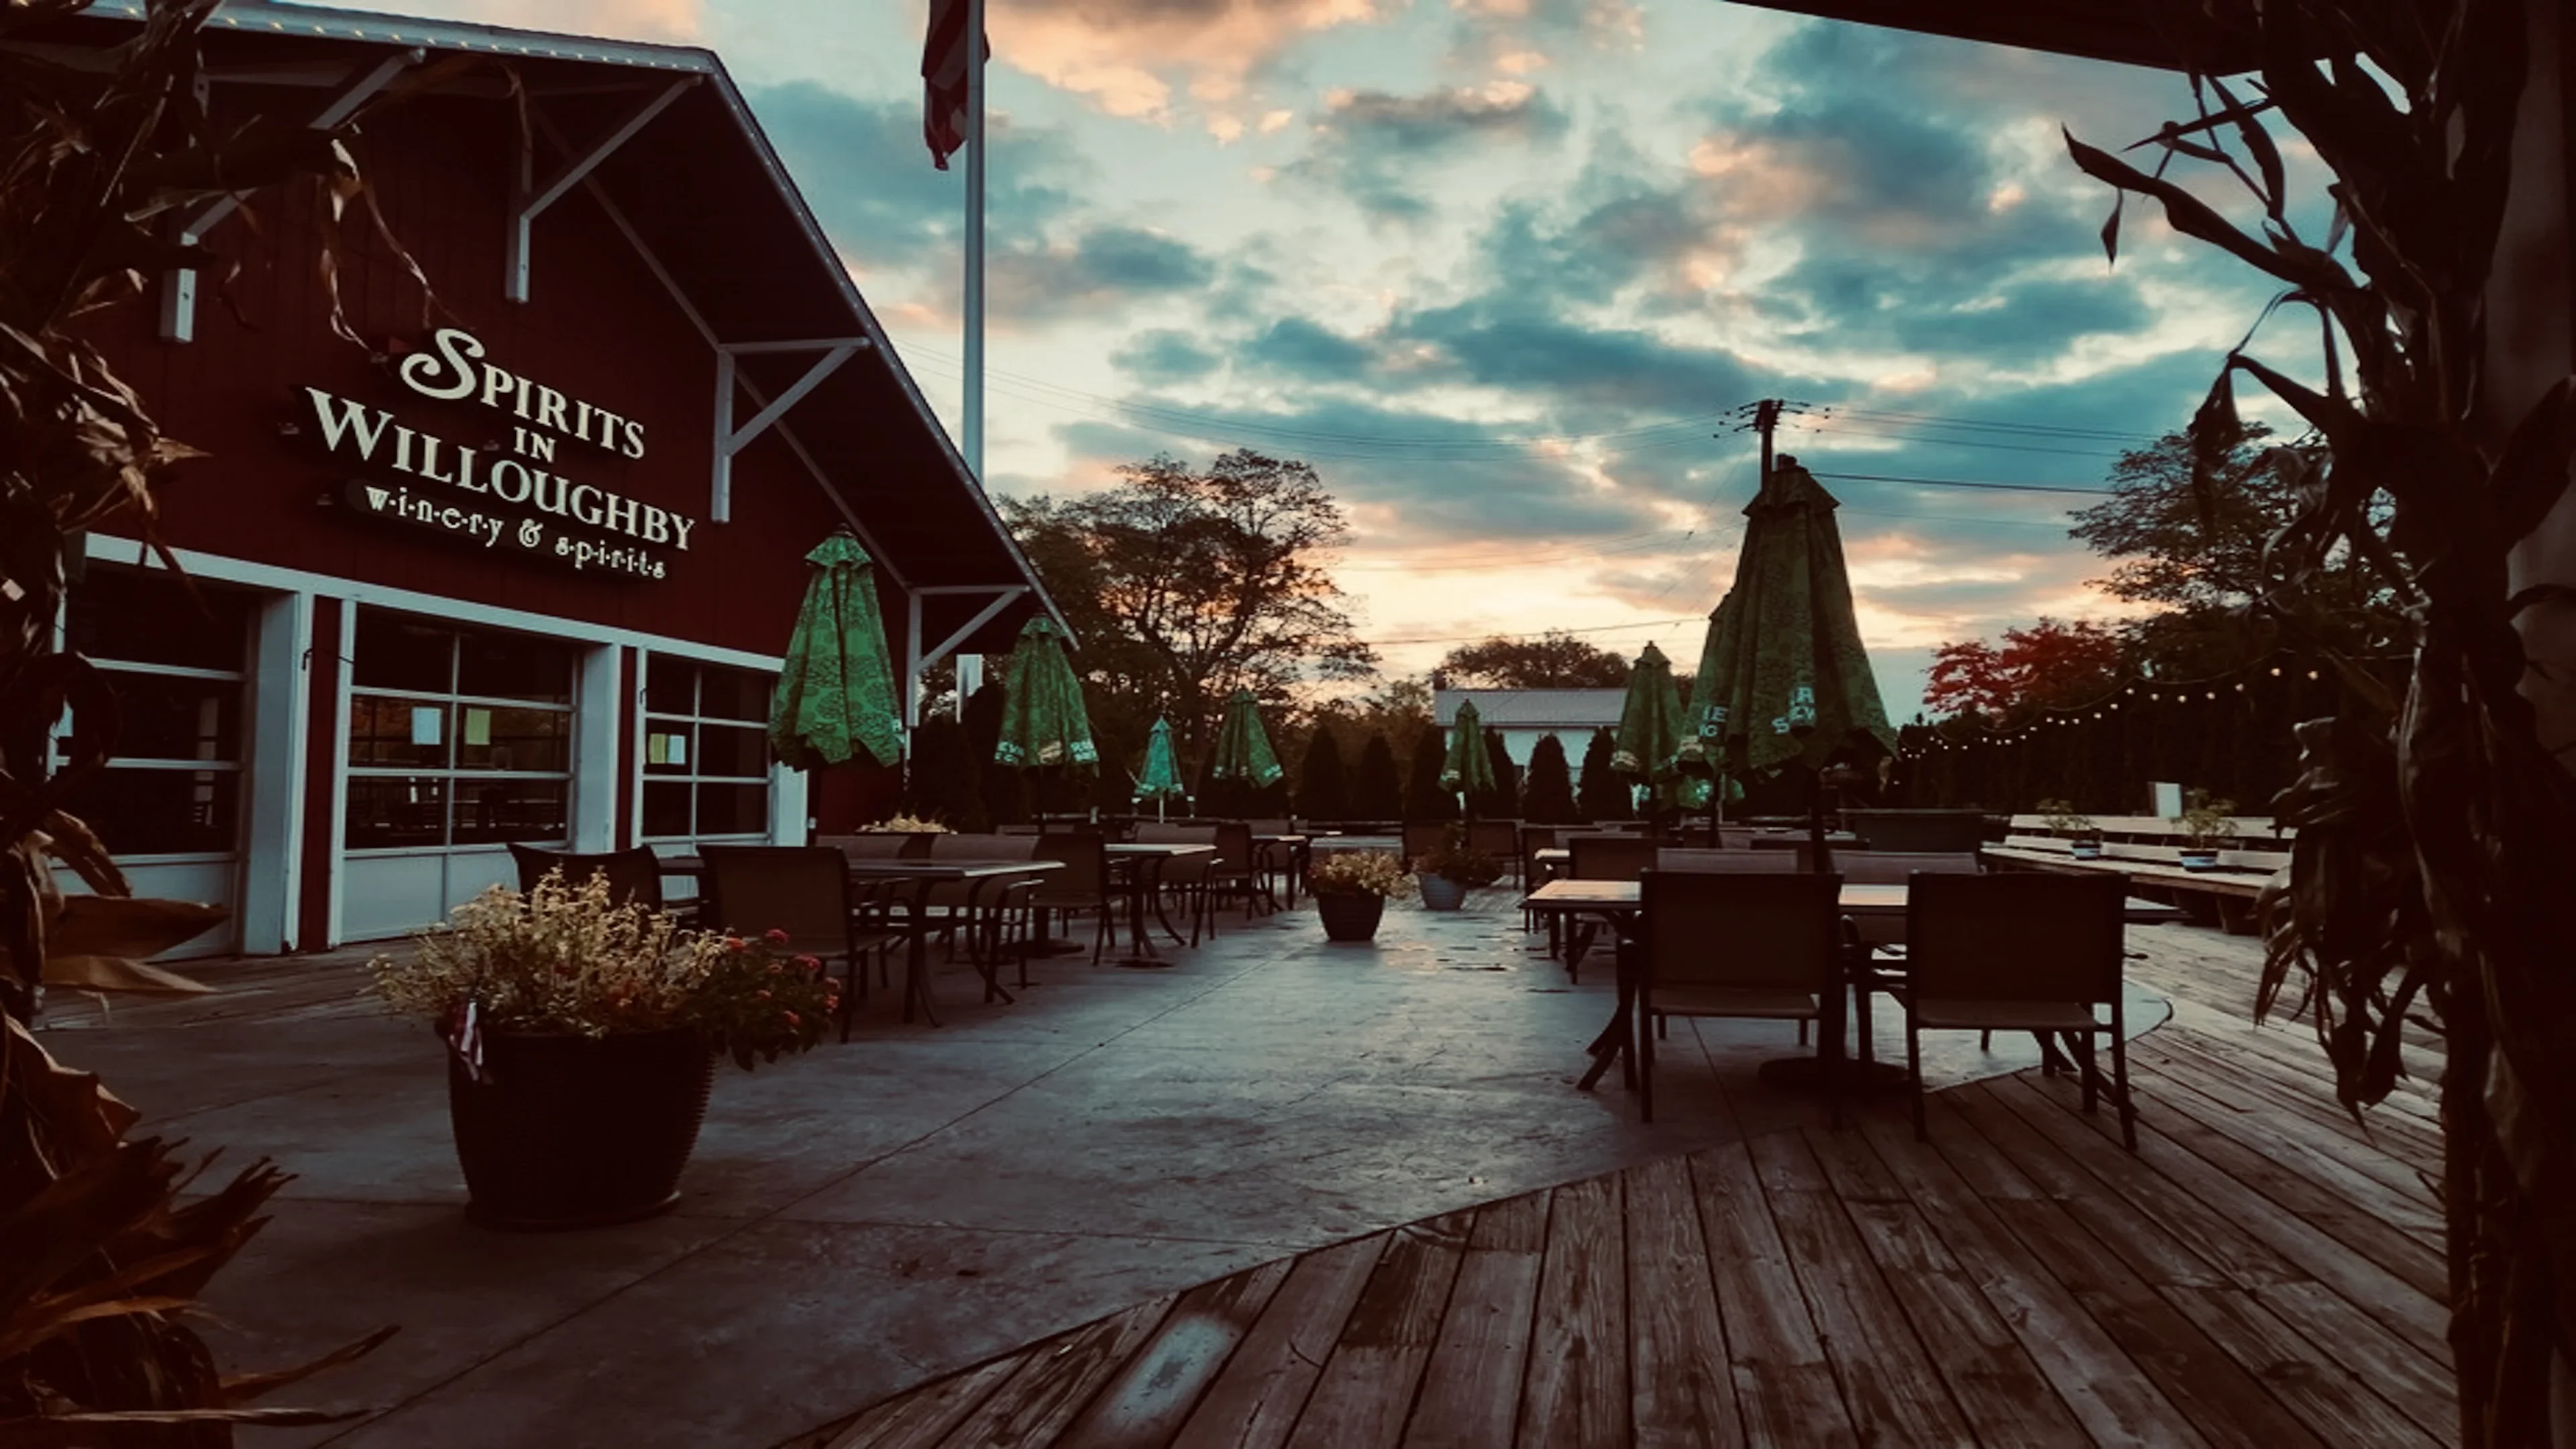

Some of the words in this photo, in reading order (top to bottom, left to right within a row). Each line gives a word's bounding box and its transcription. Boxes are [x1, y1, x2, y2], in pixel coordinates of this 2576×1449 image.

[400, 328, 645, 460] SPIRITS
[305, 386, 695, 551] WILLOUGHBY
[513, 426, 556, 463] IN
[519, 518, 544, 548] &
